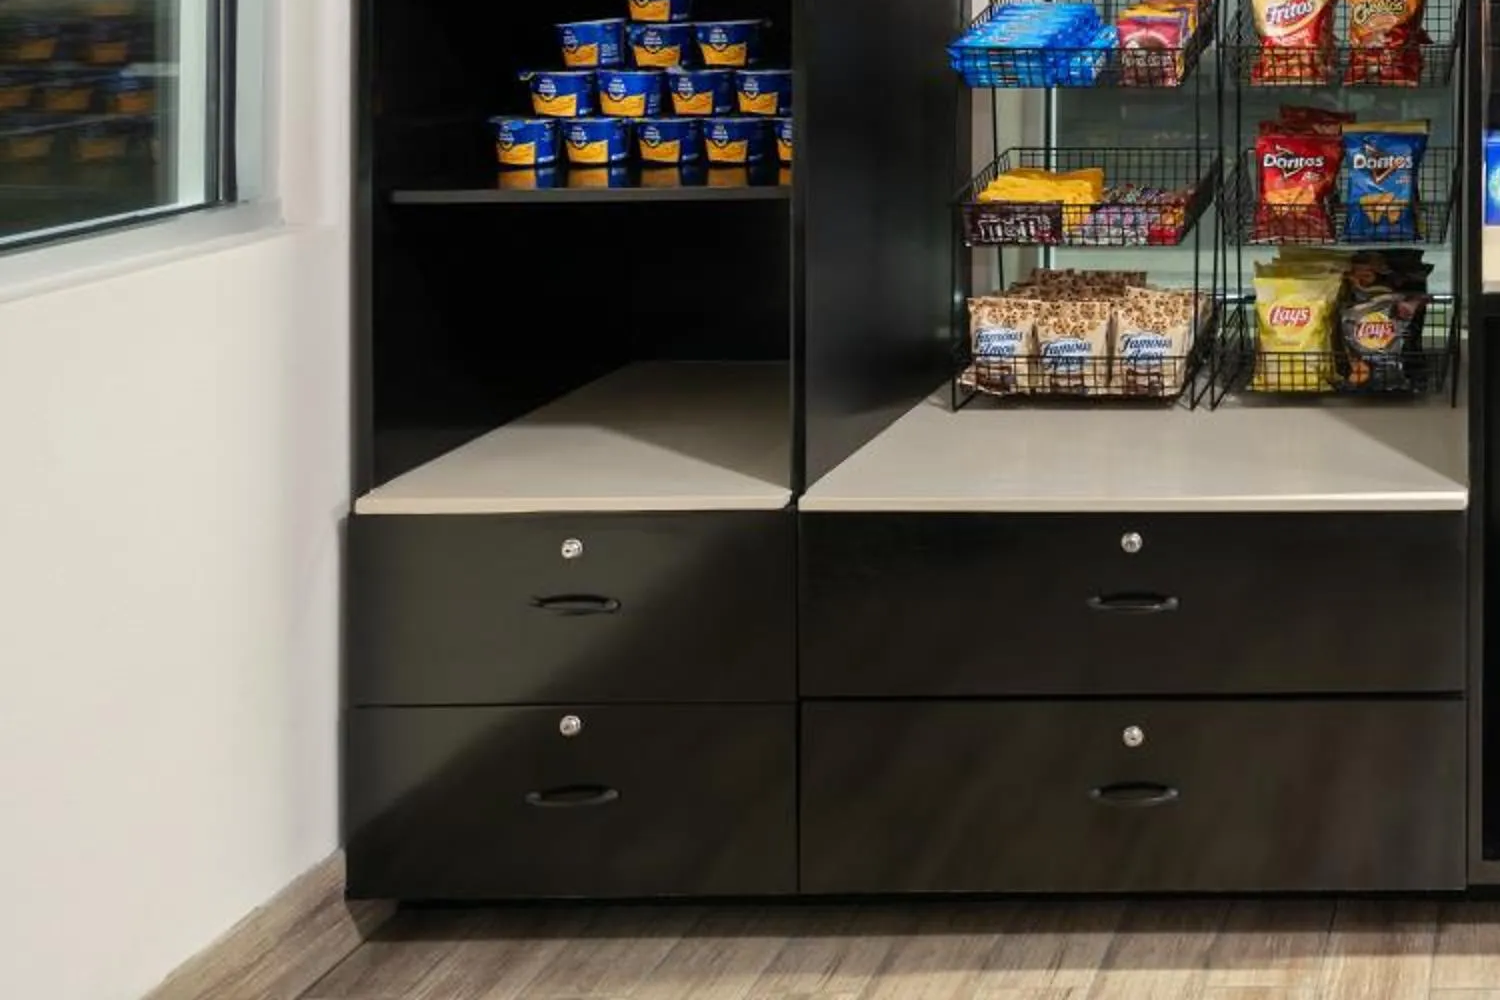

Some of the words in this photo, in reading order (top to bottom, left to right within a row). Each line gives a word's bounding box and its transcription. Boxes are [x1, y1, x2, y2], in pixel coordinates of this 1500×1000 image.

[1263, 153, 1325, 169] Doritos
[1353, 153, 1414, 169] Doritos
[1121, 333, 1173, 351] Famous
